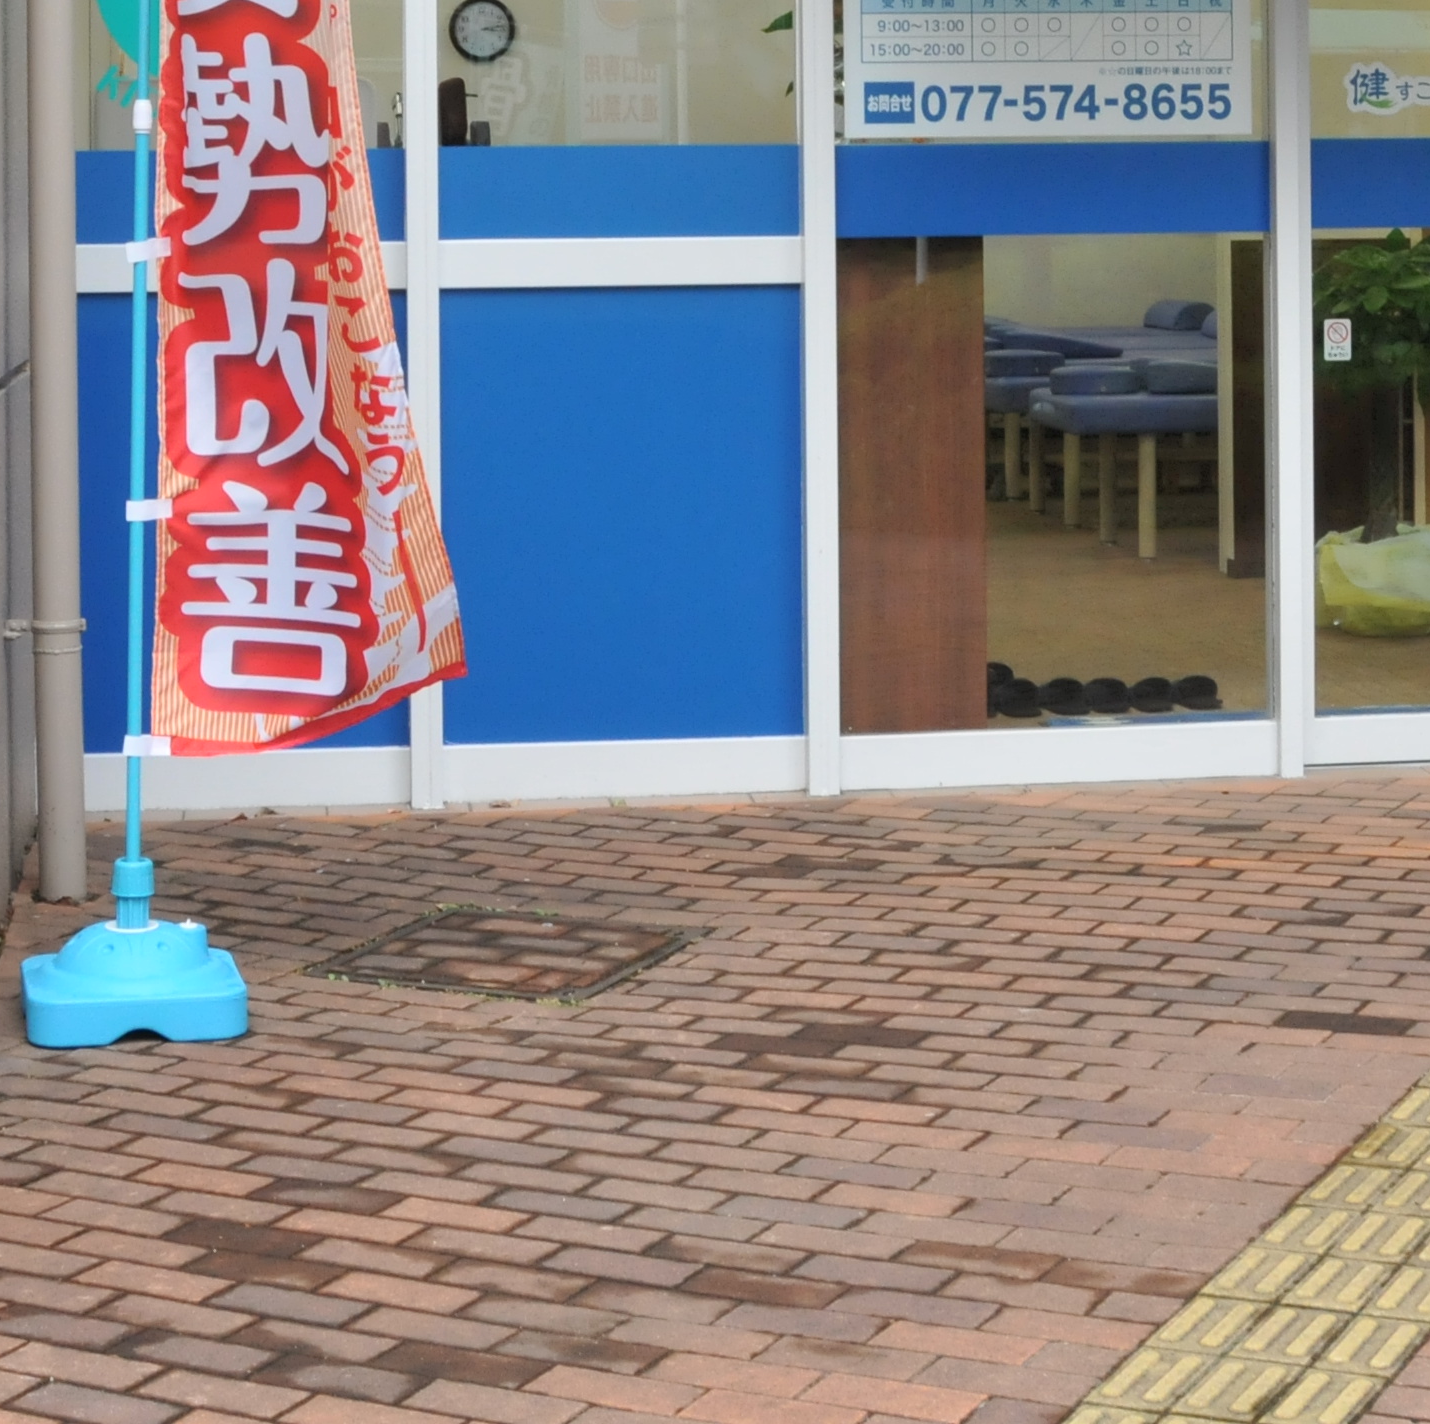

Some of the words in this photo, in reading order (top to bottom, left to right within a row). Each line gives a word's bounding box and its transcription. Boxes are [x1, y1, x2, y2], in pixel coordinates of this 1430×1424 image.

[867, 95, 912, 113] お問合せ
[921, 83, 1232, 122] 077-574-8655
